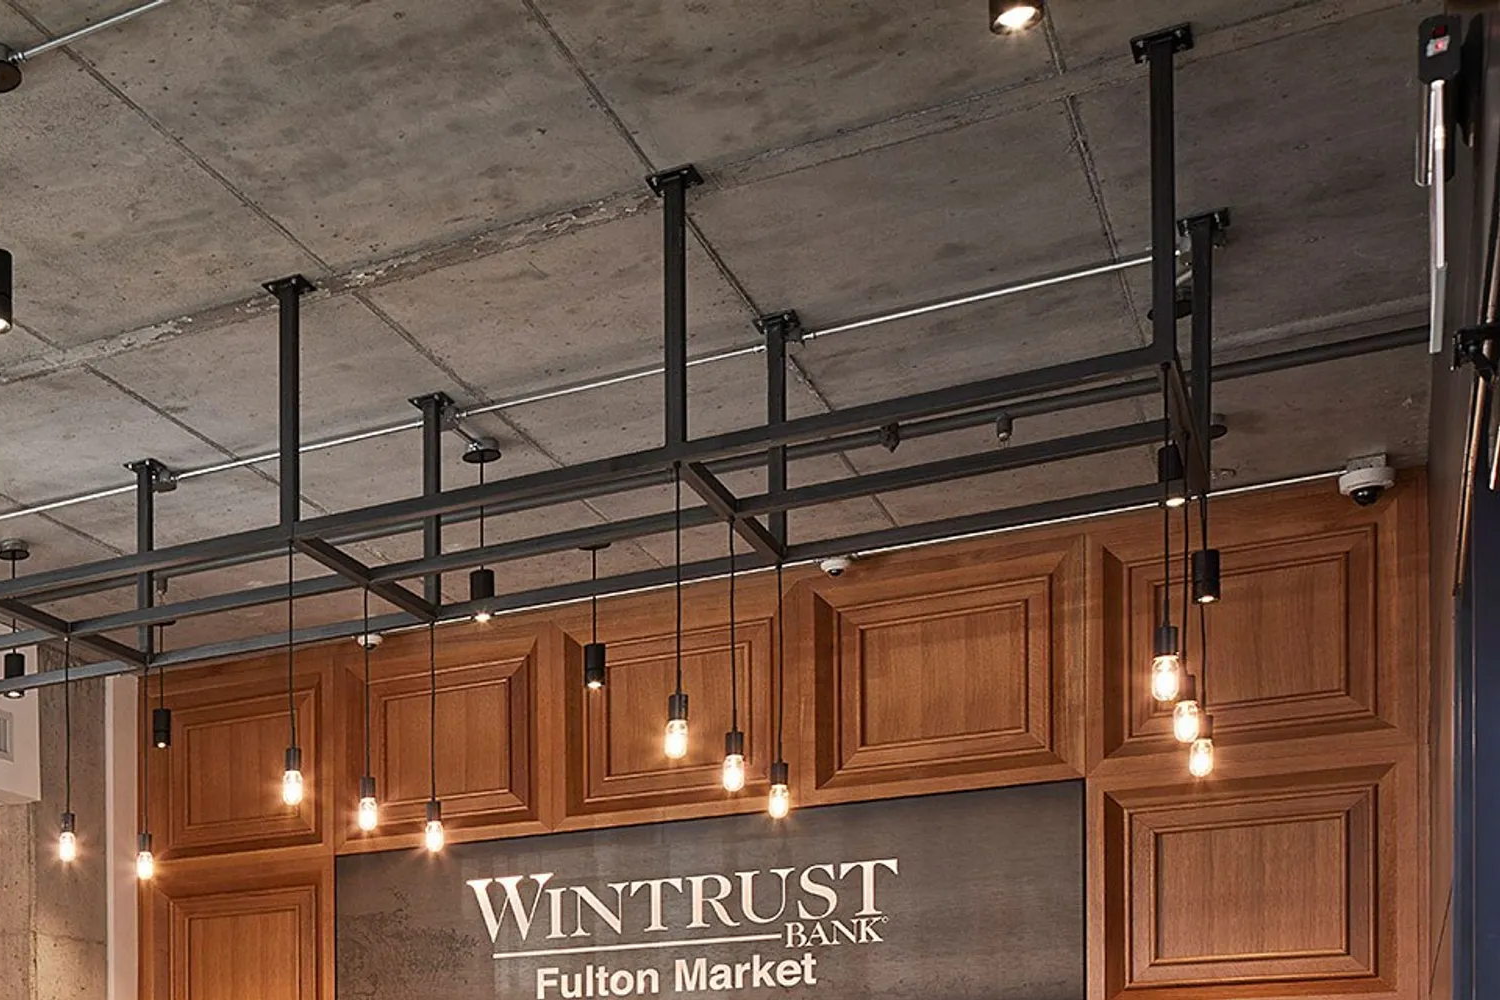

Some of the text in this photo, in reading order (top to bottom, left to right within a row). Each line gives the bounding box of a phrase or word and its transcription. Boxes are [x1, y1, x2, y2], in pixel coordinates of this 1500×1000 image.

[466, 859, 899, 943] WINTRUST
[785, 917, 884, 948] BANK
[536, 953, 817, 999] Fulton Market
